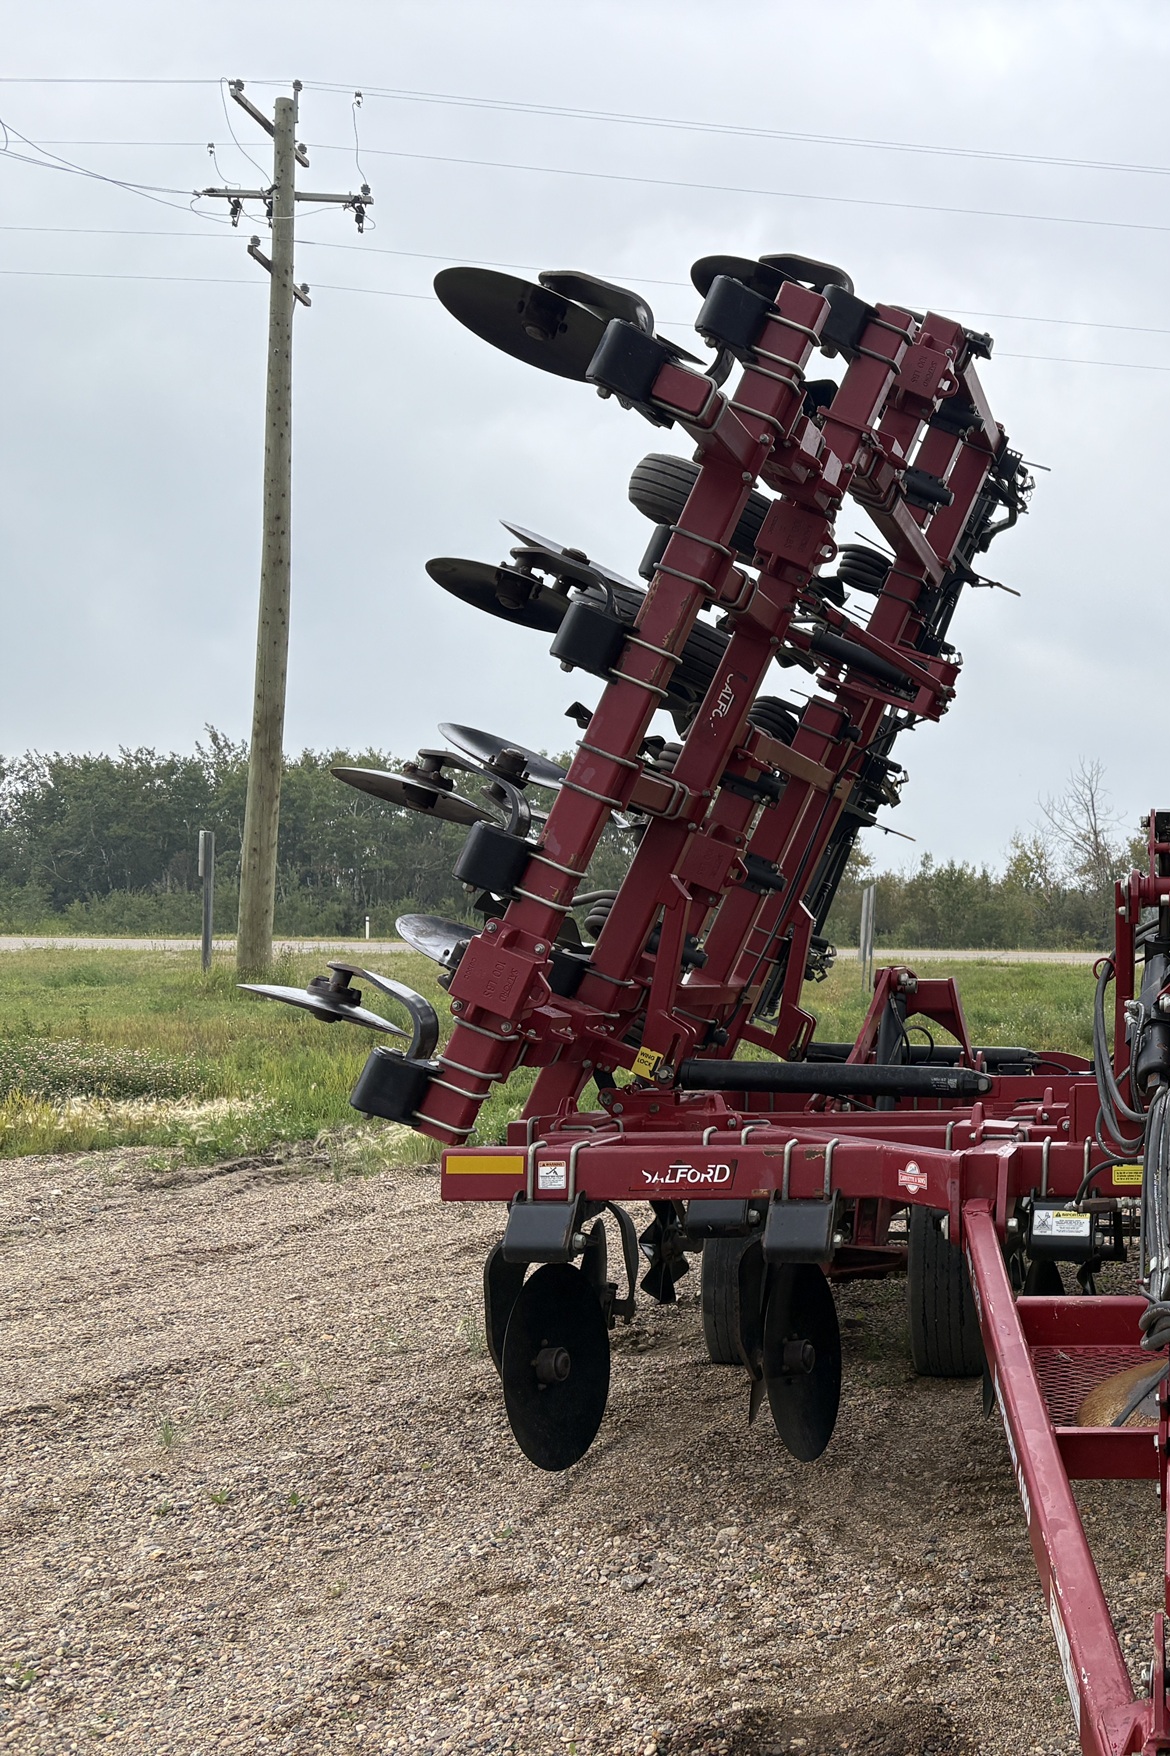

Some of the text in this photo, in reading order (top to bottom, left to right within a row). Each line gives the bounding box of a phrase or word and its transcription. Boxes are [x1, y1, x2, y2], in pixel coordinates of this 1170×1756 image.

[911, 370, 920, 383] LBS
[484, 961, 506, 999] 100 LBS
[501, 968, 518, 1002] SALFORD
[640, 1051, 655, 1060] WING
[637, 1058, 653, 1067] LOCK
